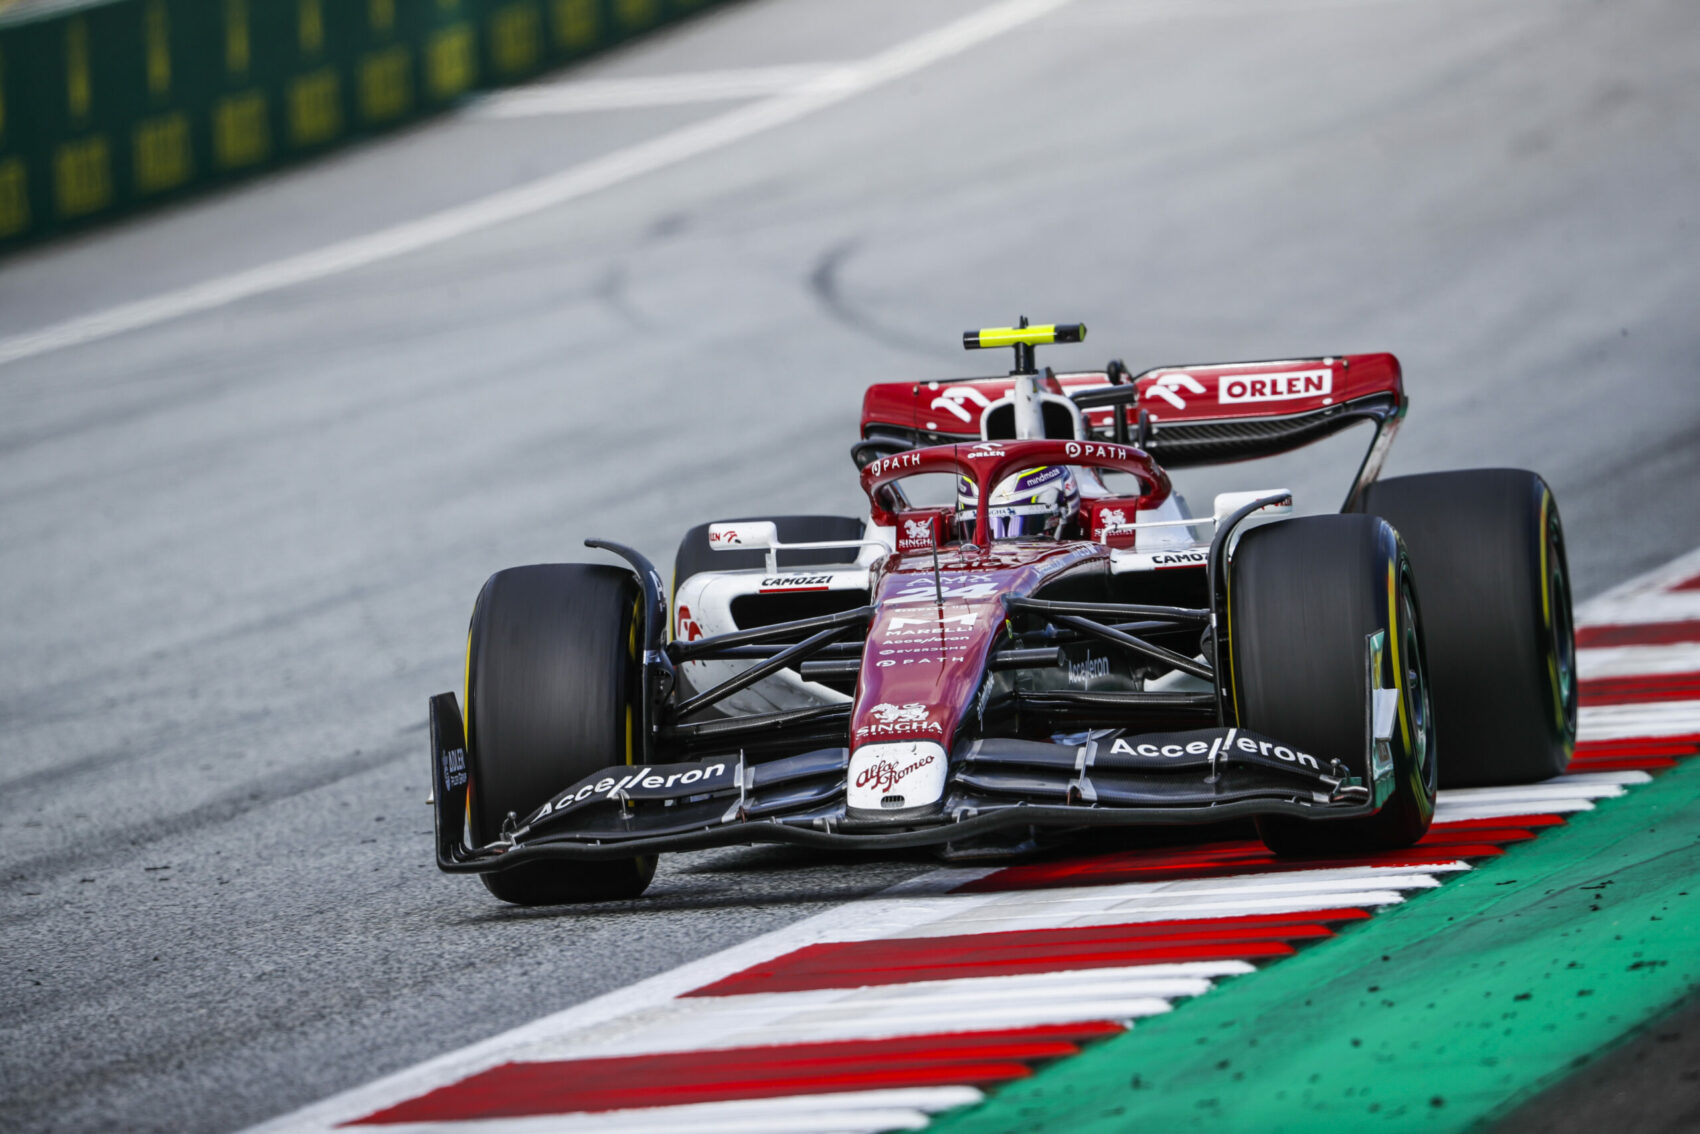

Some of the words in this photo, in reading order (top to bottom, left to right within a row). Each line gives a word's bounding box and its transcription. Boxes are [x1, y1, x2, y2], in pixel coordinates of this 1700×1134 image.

[1227, 375, 1323, 398] ORLEN
[967, 450, 1005, 459] ORLEN
[1085, 445, 1126, 460] PATH
[883, 453, 920, 471] PATH
[1152, 552, 1209, 564] CAMO
[761, 575, 833, 587] CAMOZZI
[906, 573, 993, 587] AMX
[883, 582, 999, 604] 24
[886, 626, 974, 637] MARELLI
[903, 656, 964, 665] PATH
[1068, 649, 1110, 691] Accelleron
[857, 721, 942, 735] SINGHA
[1109, 727, 1320, 770] Accelleron
[880, 755, 936, 793] Romeo
[536, 763, 726, 819] Accelleron
